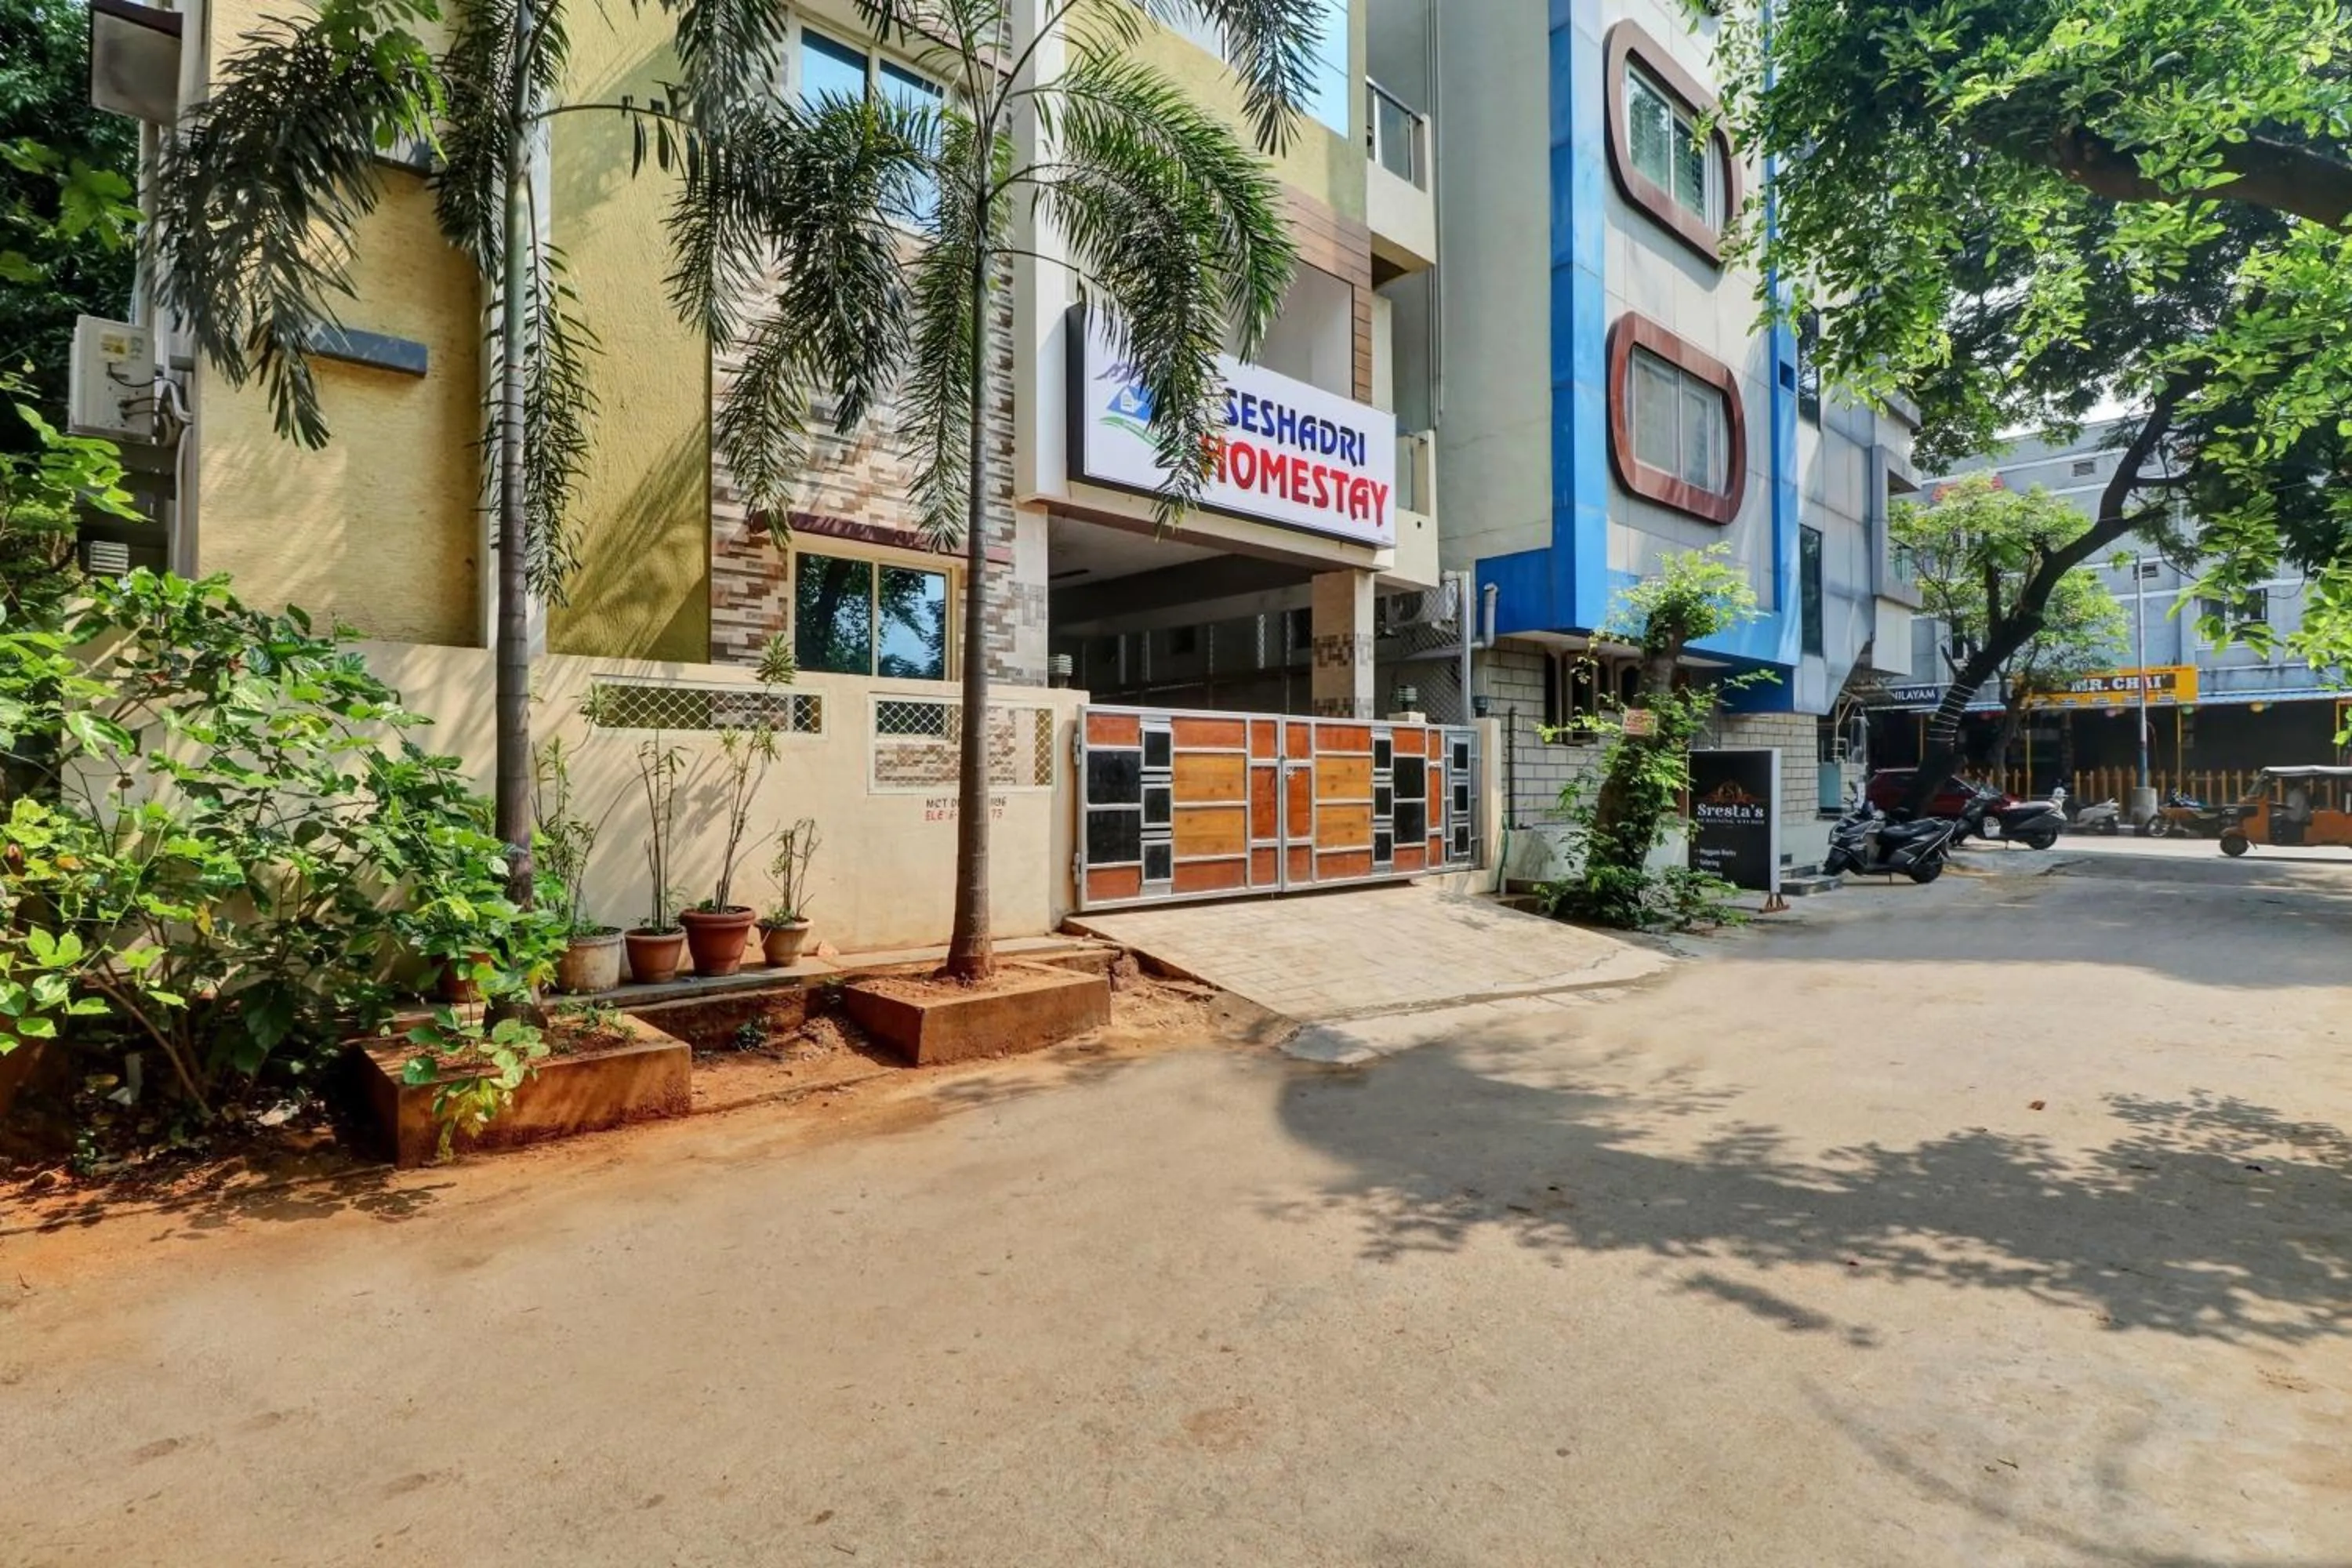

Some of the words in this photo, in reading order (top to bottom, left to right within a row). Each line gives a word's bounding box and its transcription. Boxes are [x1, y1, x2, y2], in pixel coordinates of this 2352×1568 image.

[1225, 387, 1365, 467] SESHADRI
[1200, 434, 1388, 528] HOMESTAY
[1697, 803, 1763, 817] Sresta's
